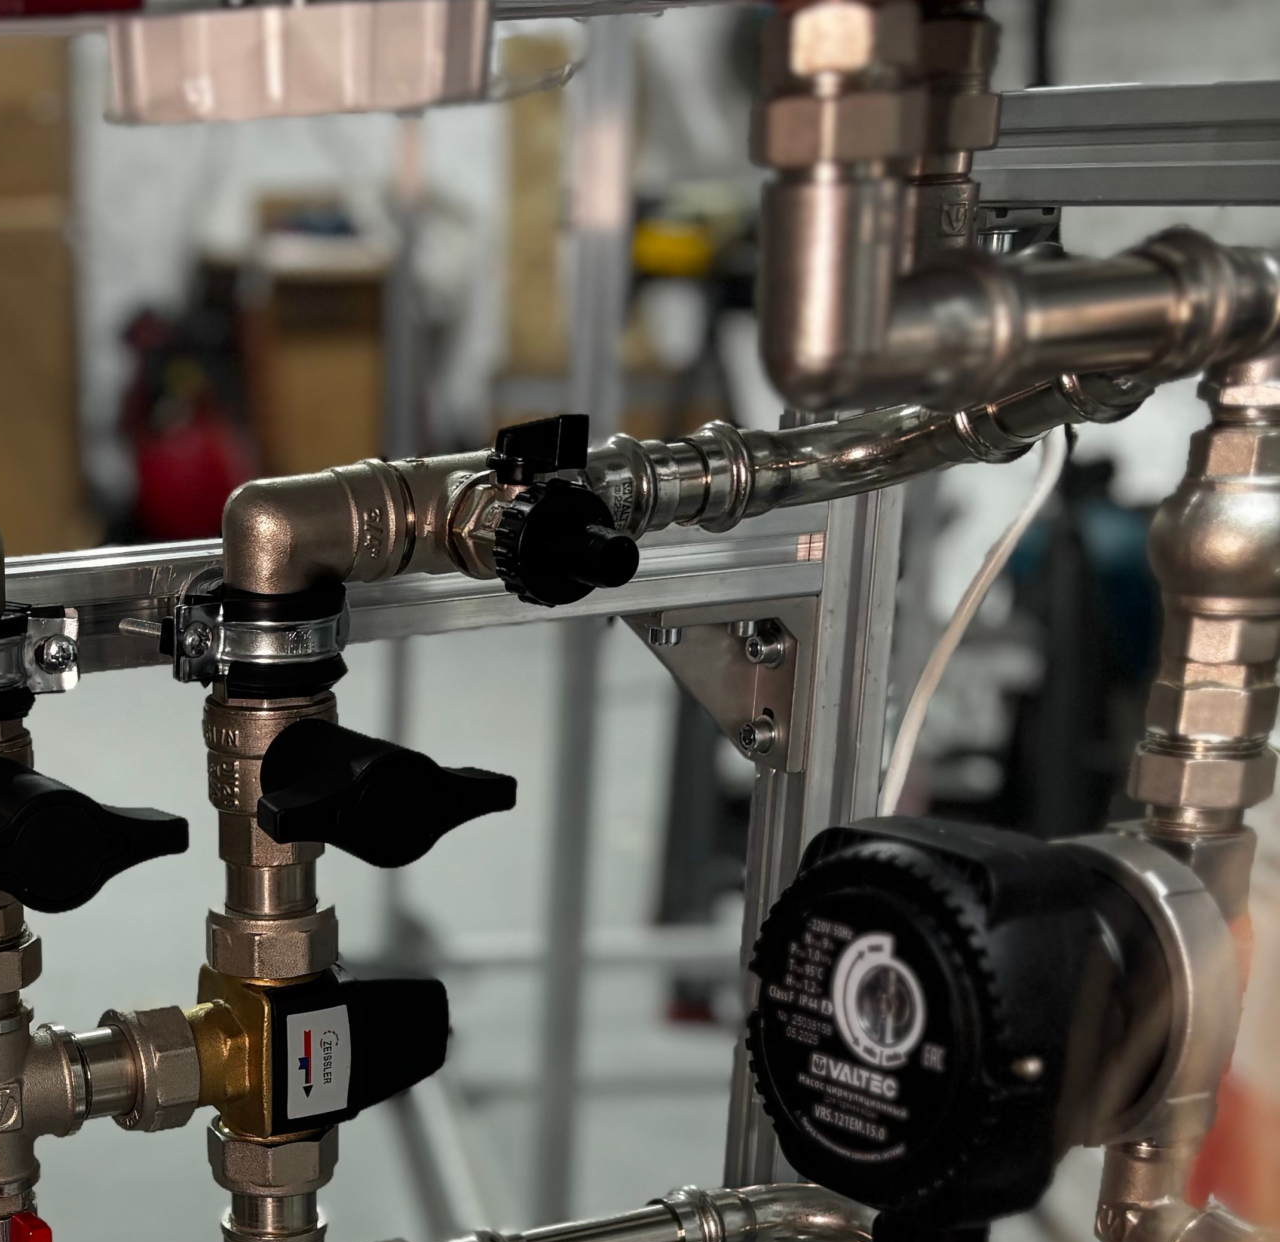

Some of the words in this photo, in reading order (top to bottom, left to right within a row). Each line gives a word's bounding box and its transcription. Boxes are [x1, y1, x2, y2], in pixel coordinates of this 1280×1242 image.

[322, 1040, 333, 1085] ZEISSLER
[827, 1058, 898, 1098] VALTEC
[798, 1073, 824, 1091] Насос
[826, 1084, 908, 1118] циркуляционный
[814, 1104, 886, 1142] VRS.121EM.15.0
